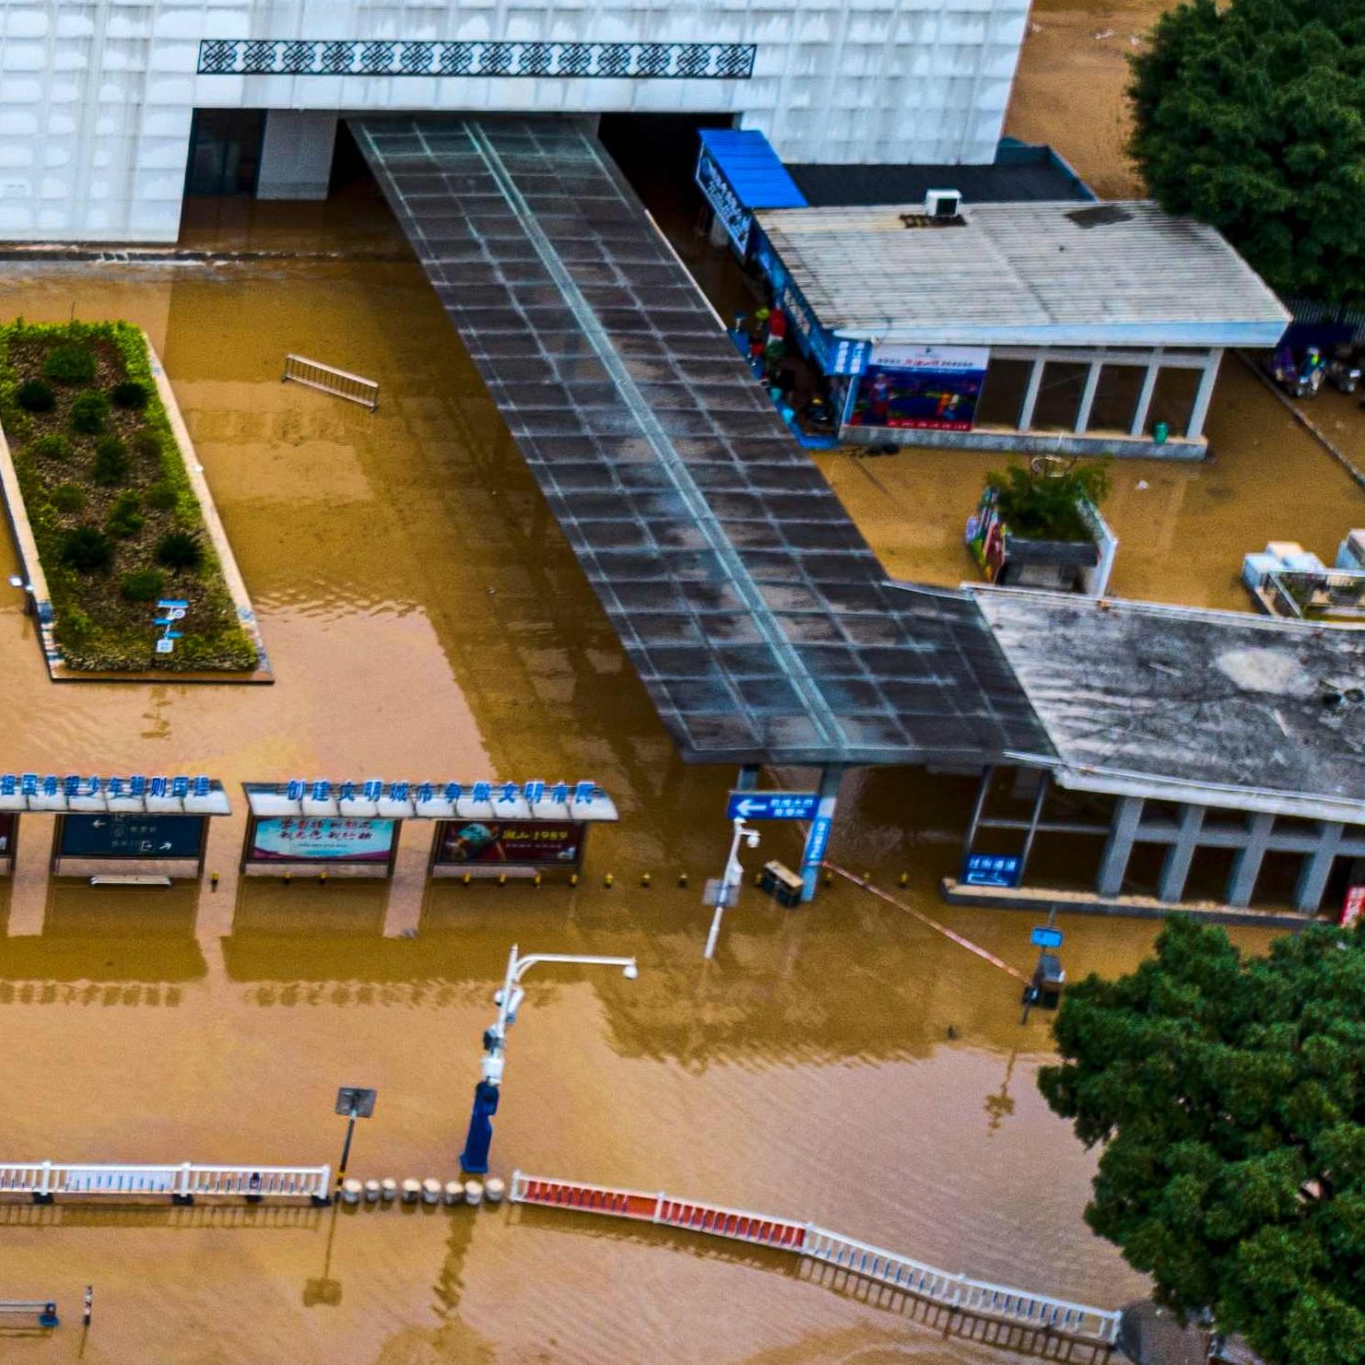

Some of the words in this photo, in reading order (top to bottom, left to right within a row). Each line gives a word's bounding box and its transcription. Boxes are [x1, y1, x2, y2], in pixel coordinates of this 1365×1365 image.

[286, 779, 595, 804] 创建文明城市争做文明市民
